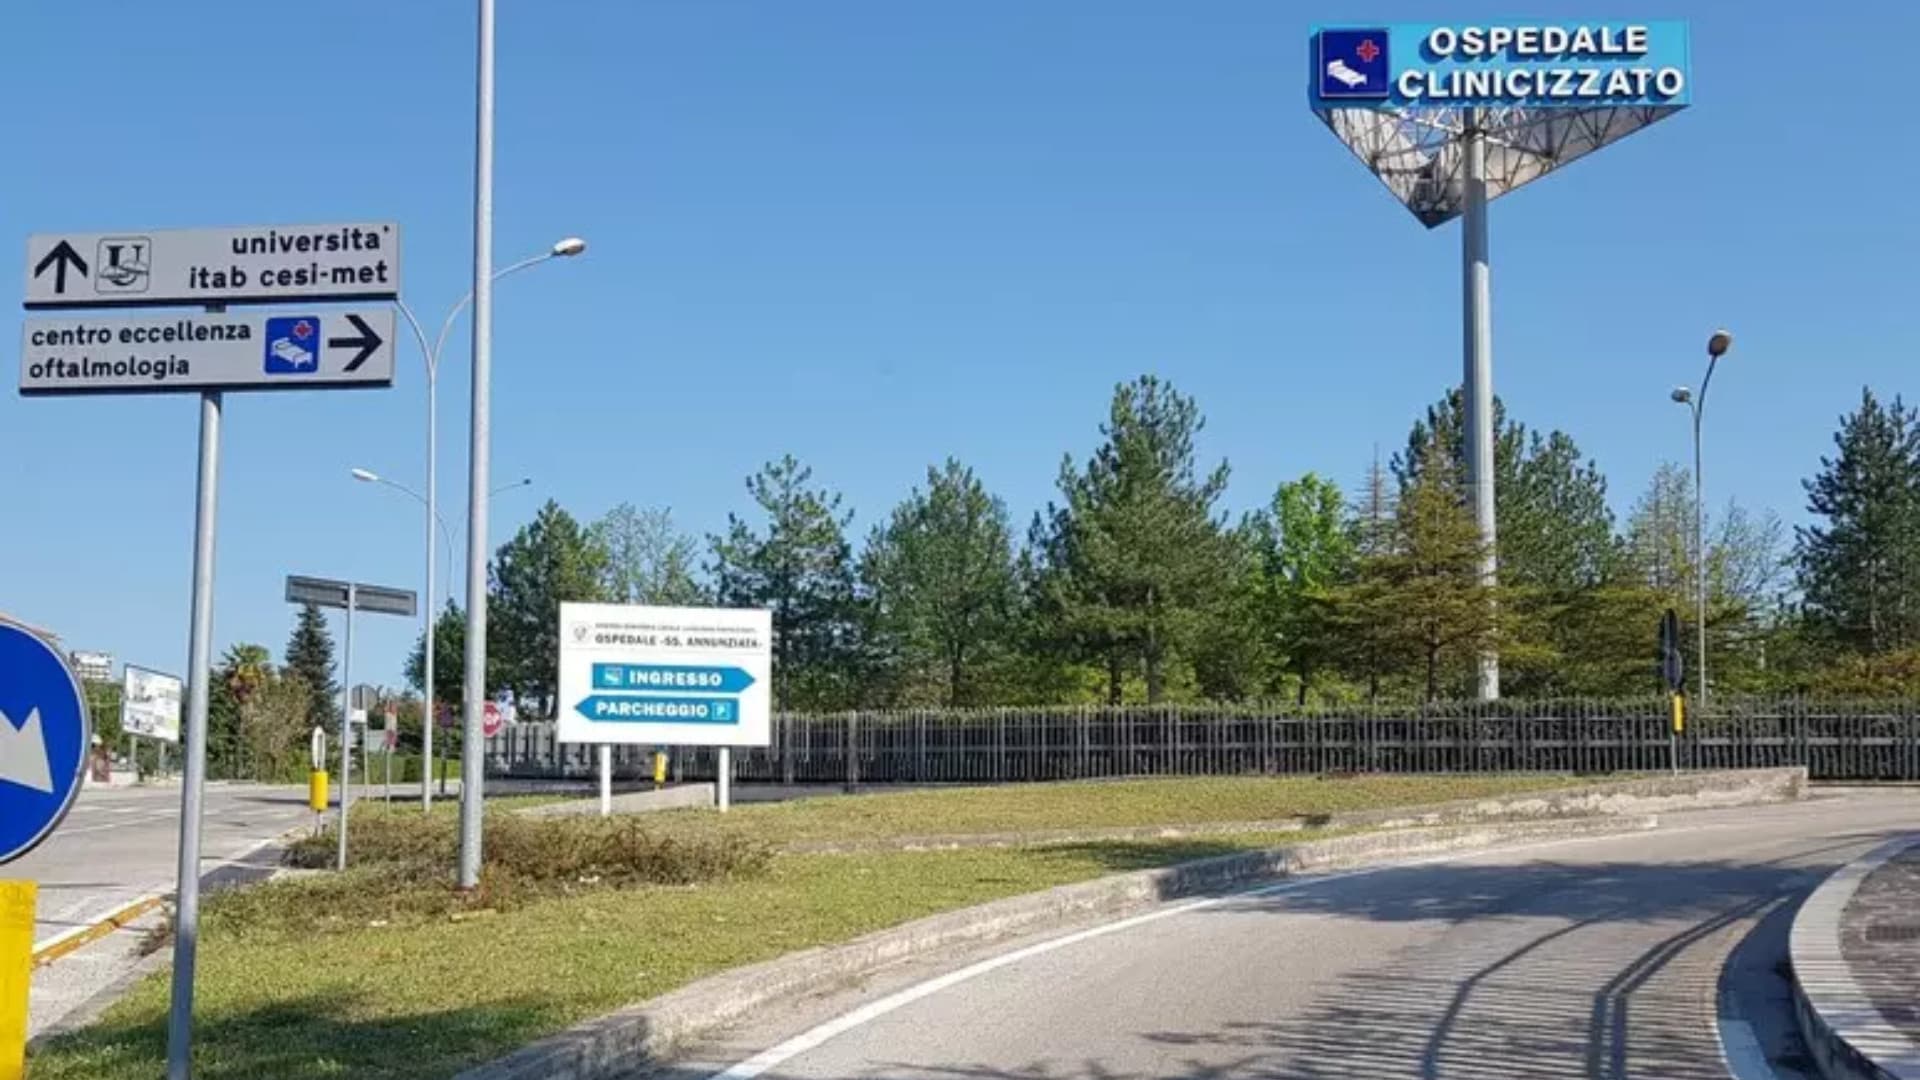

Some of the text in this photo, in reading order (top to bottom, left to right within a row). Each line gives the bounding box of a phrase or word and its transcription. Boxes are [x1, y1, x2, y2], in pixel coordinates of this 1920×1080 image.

[1429, 25, 1649, 55] OSPEDALE
[1398, 67, 1685, 98] CLINICIZZATO
[189, 260, 388, 289] itab cesi-met
[31, 321, 252, 346] centro eccellenza
[29, 354, 190, 380] oftalmologia
[595, 632, 656, 646] OSPEDALE
[629, 669, 723, 686] INGRESSO
[595, 701, 709, 718] PARCHEGGIO
